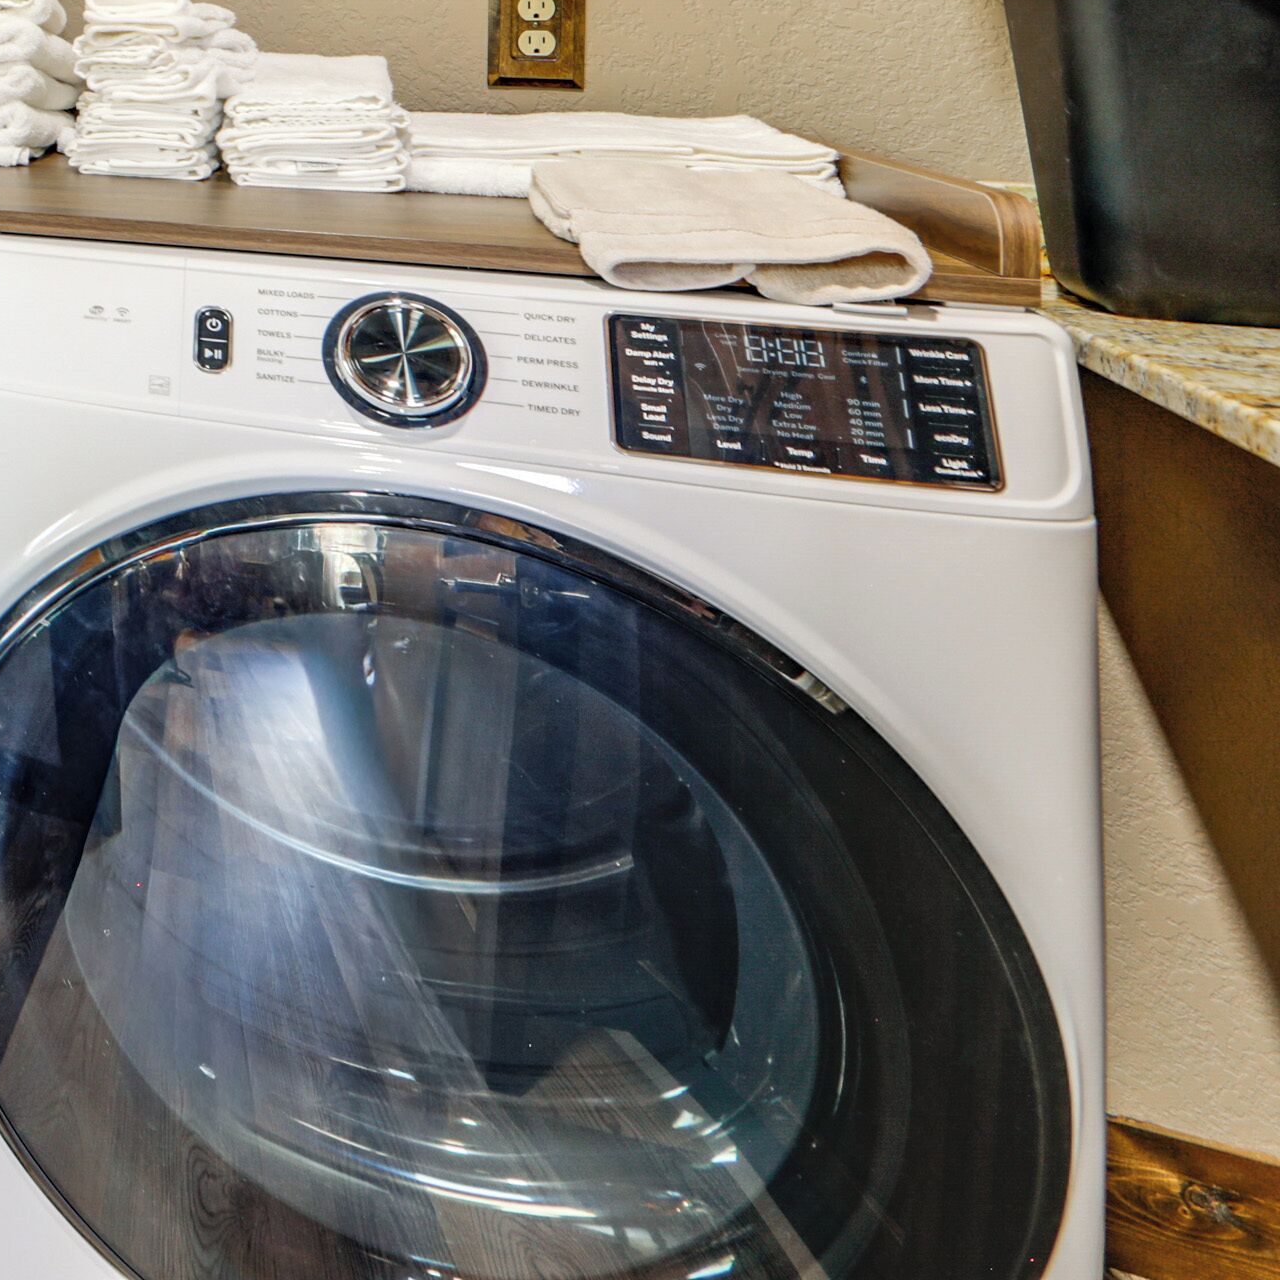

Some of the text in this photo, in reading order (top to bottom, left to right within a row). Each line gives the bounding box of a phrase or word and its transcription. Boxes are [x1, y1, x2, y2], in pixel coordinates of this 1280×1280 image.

[258, 288, 315, 299] MIXED LOADS
[257, 308, 298, 317] COTTONS
[524, 312, 576, 323] QUICK DRY
[640, 323, 656, 333] My
[257, 329, 292, 339] TOWELS
[524, 333, 577, 345] DELICATES
[631, 331, 668, 342] Settings
[257, 348, 284, 357] BULKY
[625, 348, 675, 360] Damp Alert
[908, 348, 969, 361] Wrinkle Care
[517, 356, 579, 369] PERM PRESS
[763, 368, 788, 377] Drying
[256, 373, 295, 383] SANITIZE
[631, 374, 674, 387] Delay Dry
[913, 375, 964, 386] More Time
[522, 380, 580, 392] DEWRINKLE
[704, 394, 744, 405] More Dry
[780, 392, 802, 400] High
[774, 401, 812, 410] Medium
[847, 398, 860, 406] 90
[528, 403, 581, 416] TIMED DRY
[641, 403, 667, 413] Small
[716, 404, 732, 413] Dry
[848, 408, 861, 416] 60
[941, 405, 966, 414] Time
[643, 412, 666, 422] Load
[707, 414, 744, 424] Less Dry
[713, 423, 740, 432] Damp
[773, 420, 797, 429] Extra
[642, 431, 672, 442] Sound
[716, 440, 742, 450] Level
[785, 447, 814, 458] Temp
[860, 454, 887, 465] Time
[941, 458, 968, 469] Light
